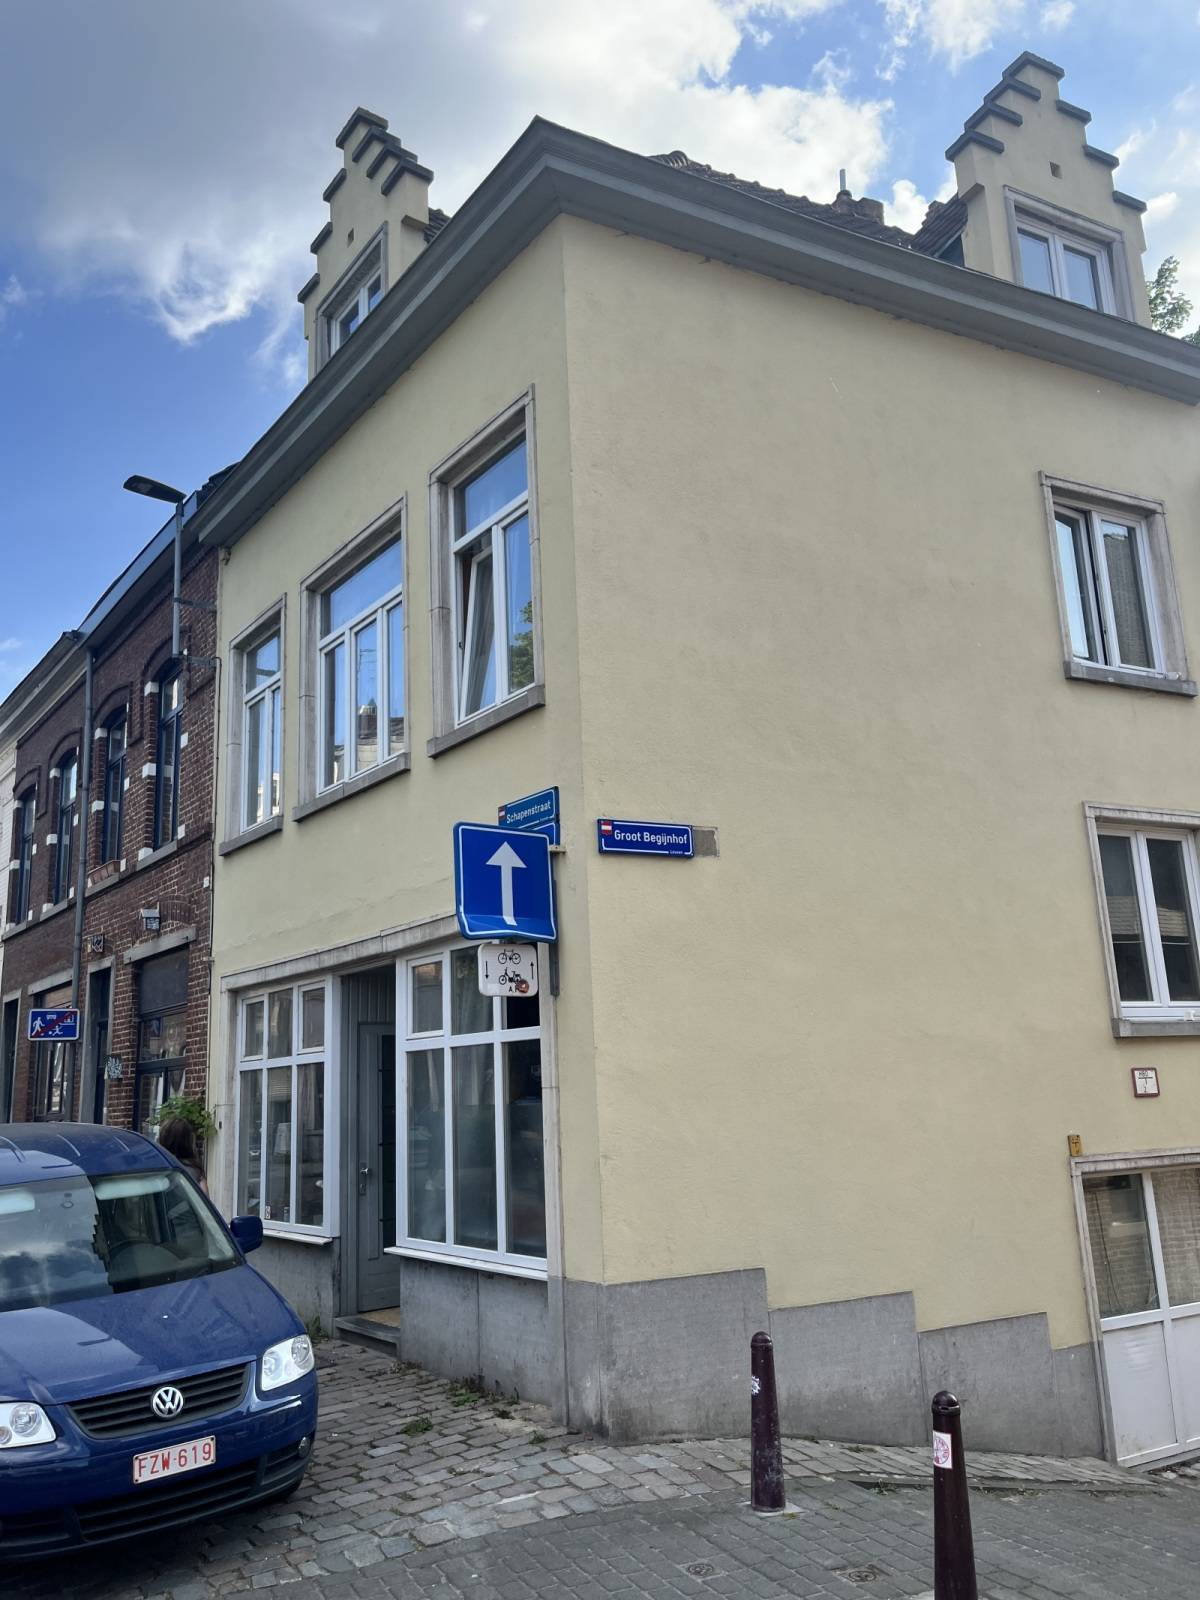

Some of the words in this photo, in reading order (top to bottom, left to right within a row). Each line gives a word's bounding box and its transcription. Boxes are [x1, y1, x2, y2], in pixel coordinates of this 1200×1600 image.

[506, 800, 551, 824] Schapenstraat
[614, 829, 641, 842] Groot
[643, 831, 688, 846] Begijnhof
